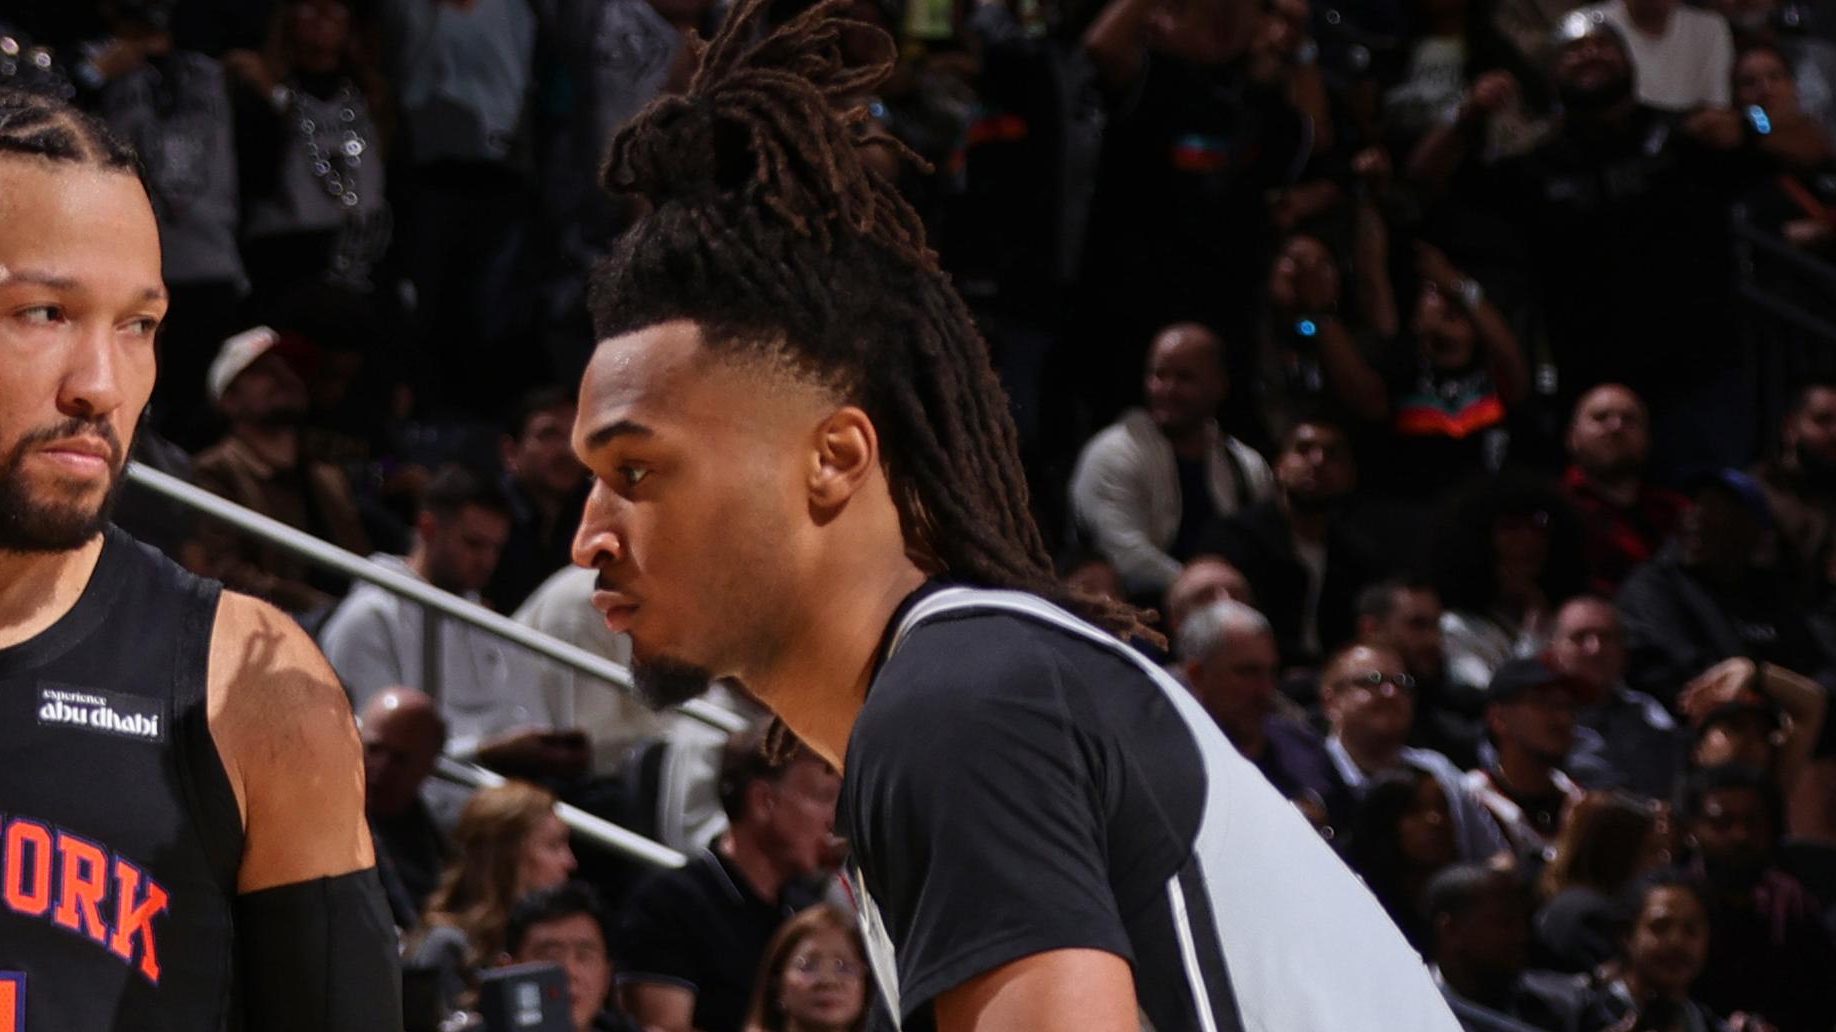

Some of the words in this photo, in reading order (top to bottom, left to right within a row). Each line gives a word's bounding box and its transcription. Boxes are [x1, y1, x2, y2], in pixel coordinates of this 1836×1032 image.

[42, 688, 108, 706] experience
[39, 701, 88, 724] abu
[89, 706, 159, 736] dhabi
